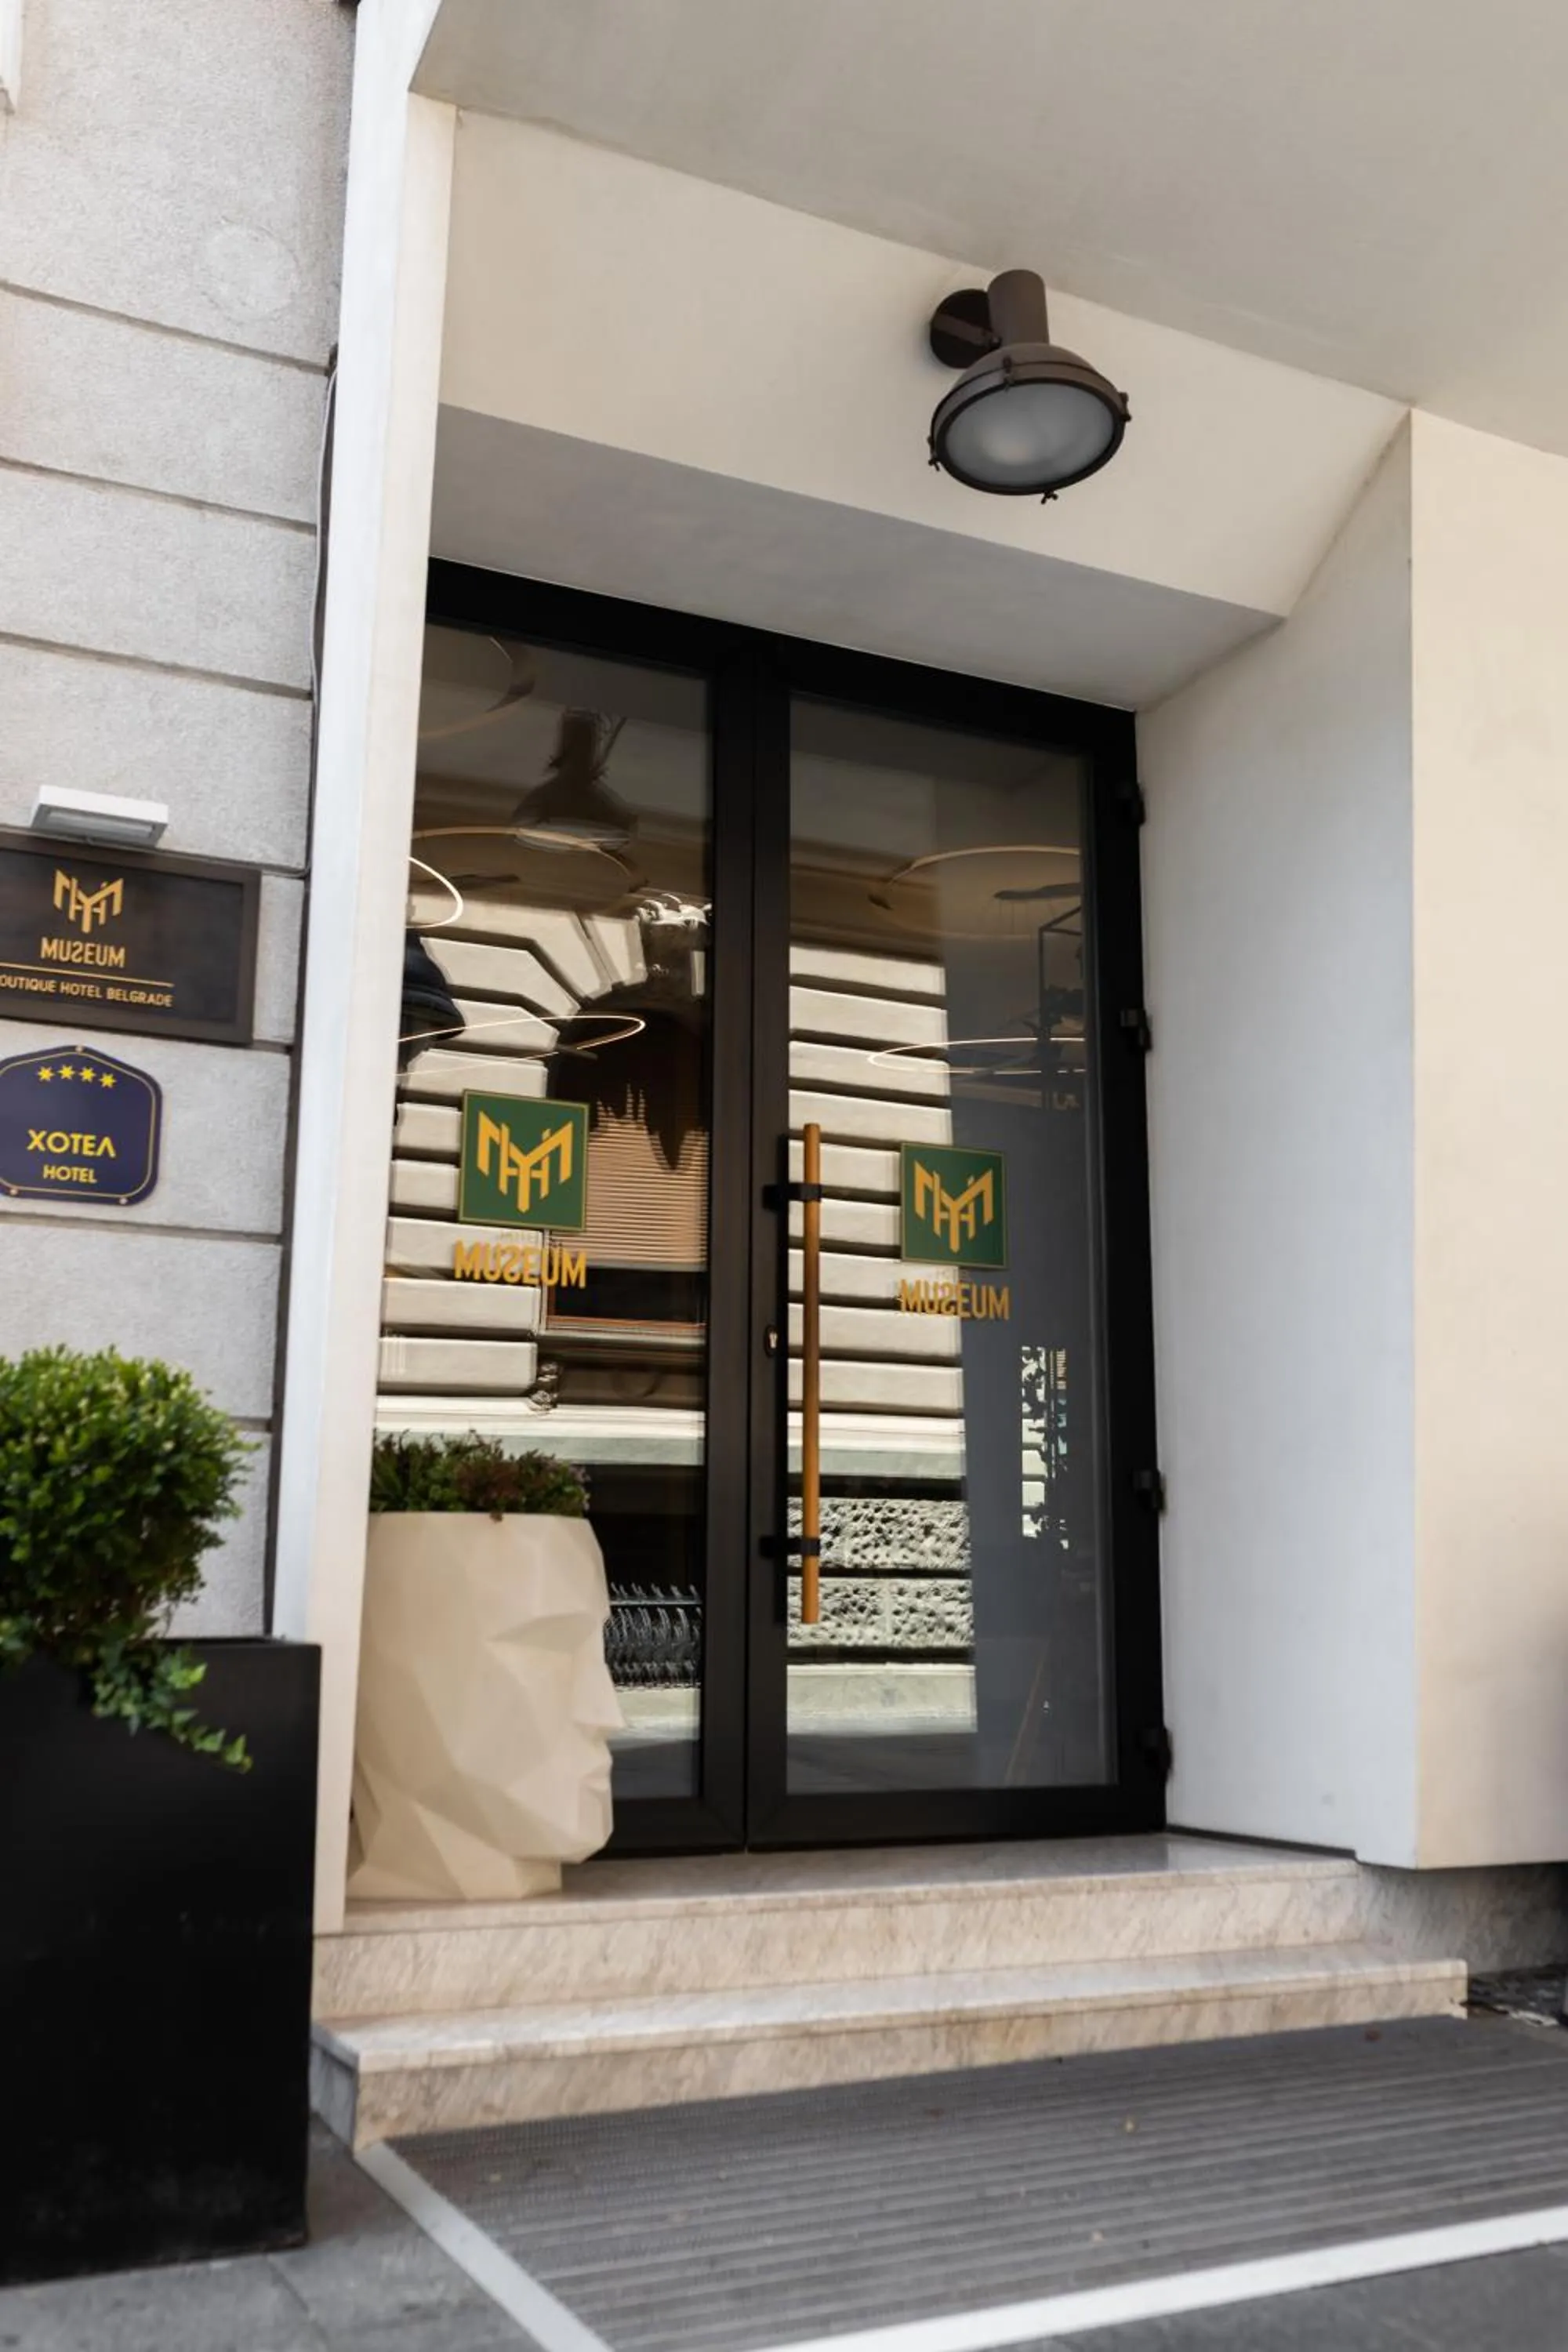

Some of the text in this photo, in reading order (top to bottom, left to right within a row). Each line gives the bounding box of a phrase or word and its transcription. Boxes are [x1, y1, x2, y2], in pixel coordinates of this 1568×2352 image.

[41, 938, 125, 968] MUSEUM
[60, 982, 102, 998] HOTEL
[107, 987, 172, 1007] BELGRADE
[43, 1164, 98, 1184] HOTEL
[454, 1238, 586, 1289] MUSEUM
[898, 1279, 1010, 1321] MUSEUM
